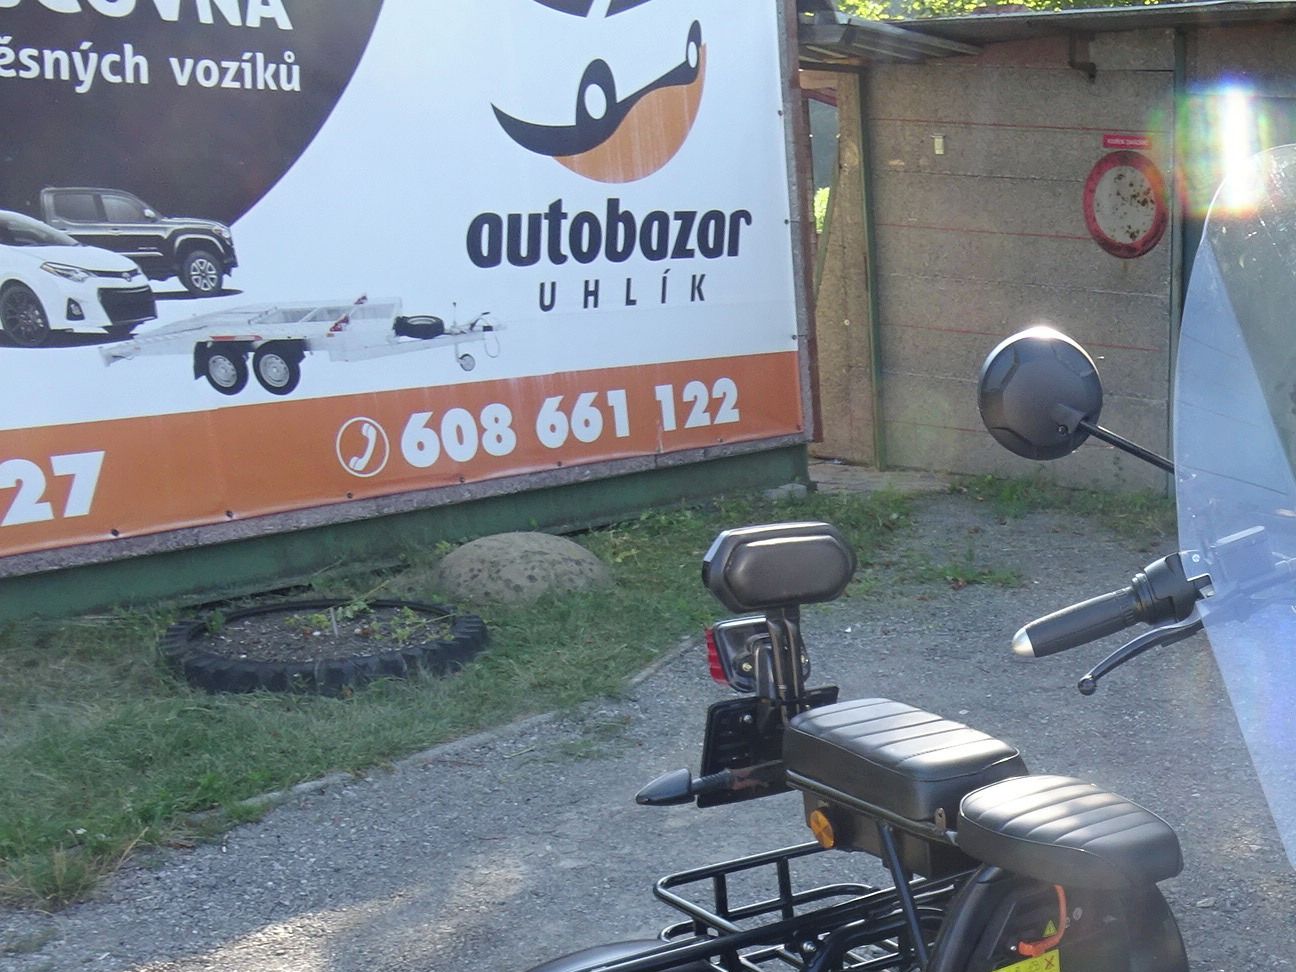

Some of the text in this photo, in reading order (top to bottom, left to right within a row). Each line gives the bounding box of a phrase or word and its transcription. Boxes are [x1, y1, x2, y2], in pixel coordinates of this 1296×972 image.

[0, 36, 301, 94] ěsných vozíků
[466, 198, 753, 269] autobazar
[539, 268, 706, 312] UHLÍK
[401, 377, 740, 468] 608 661 122
[0, 451, 106, 527] 27
